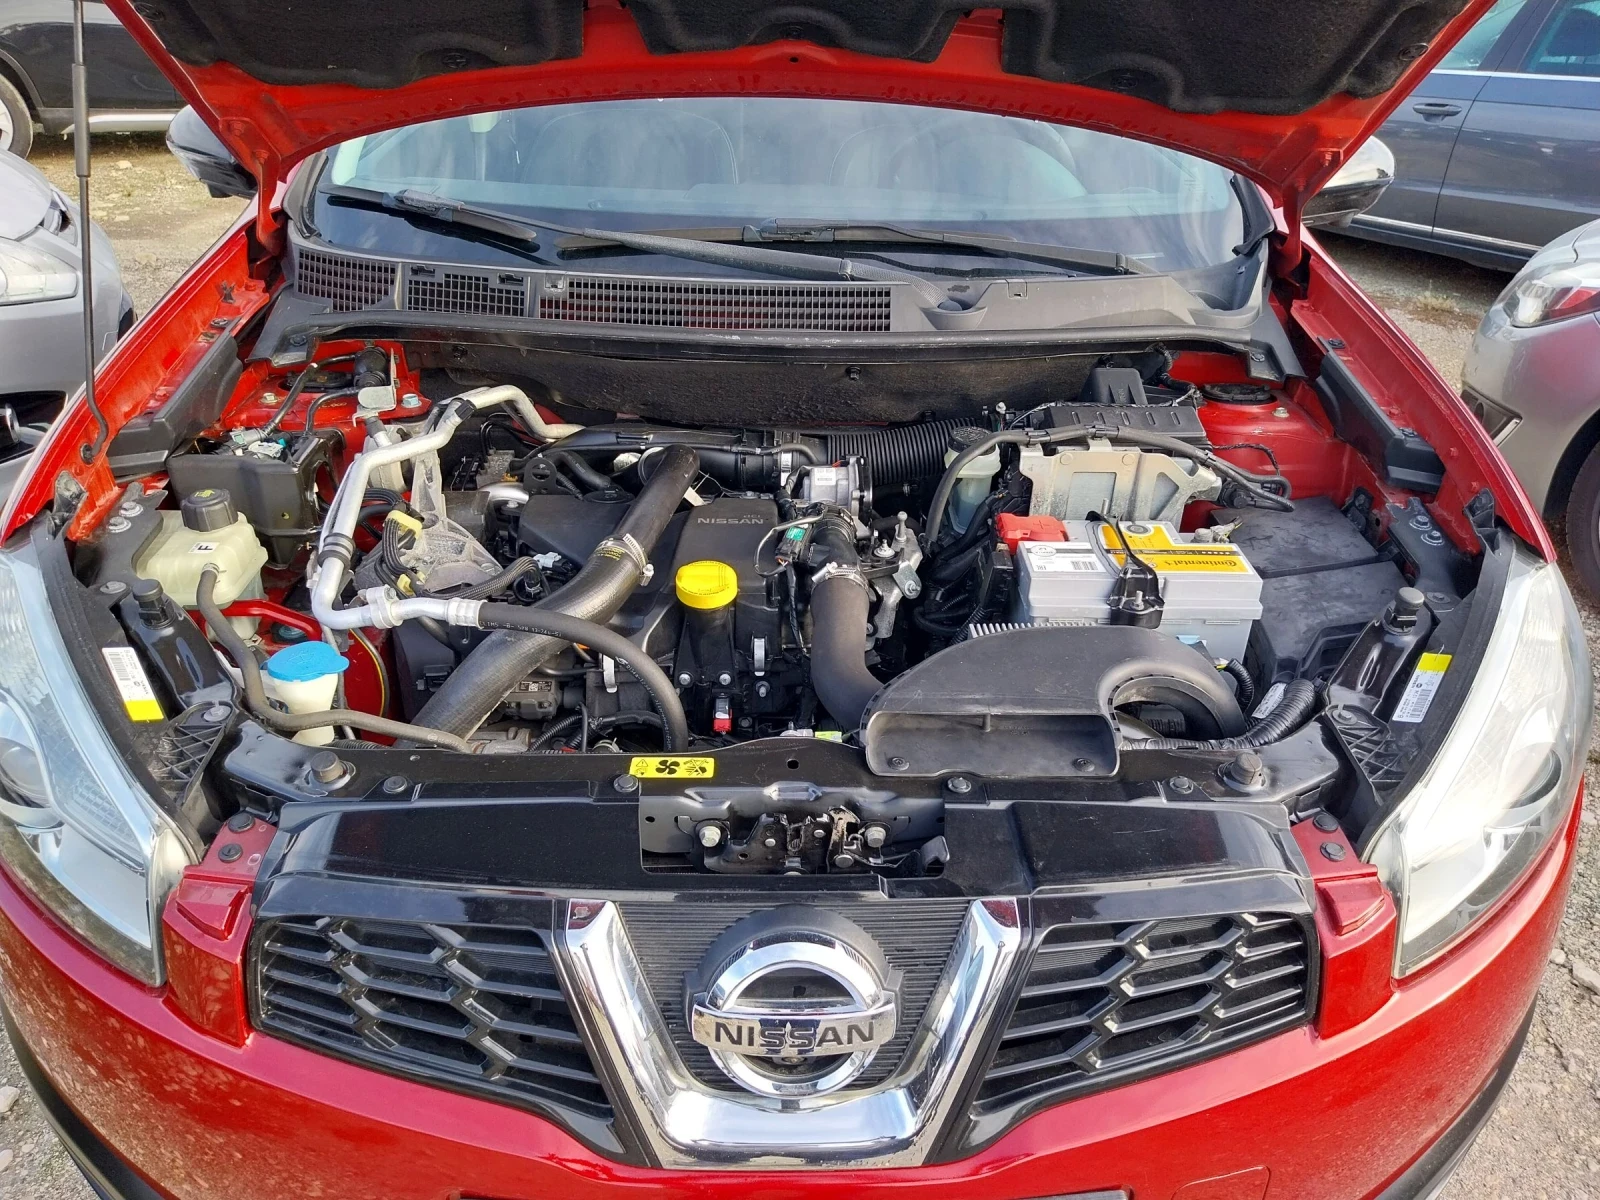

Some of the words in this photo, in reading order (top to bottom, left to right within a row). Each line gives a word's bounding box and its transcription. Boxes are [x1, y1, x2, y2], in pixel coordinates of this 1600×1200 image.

[697, 517, 764, 525] NISSAN
[1173, 559, 1237, 567] Continental
[714, 1021, 875, 1049] NISSAN
